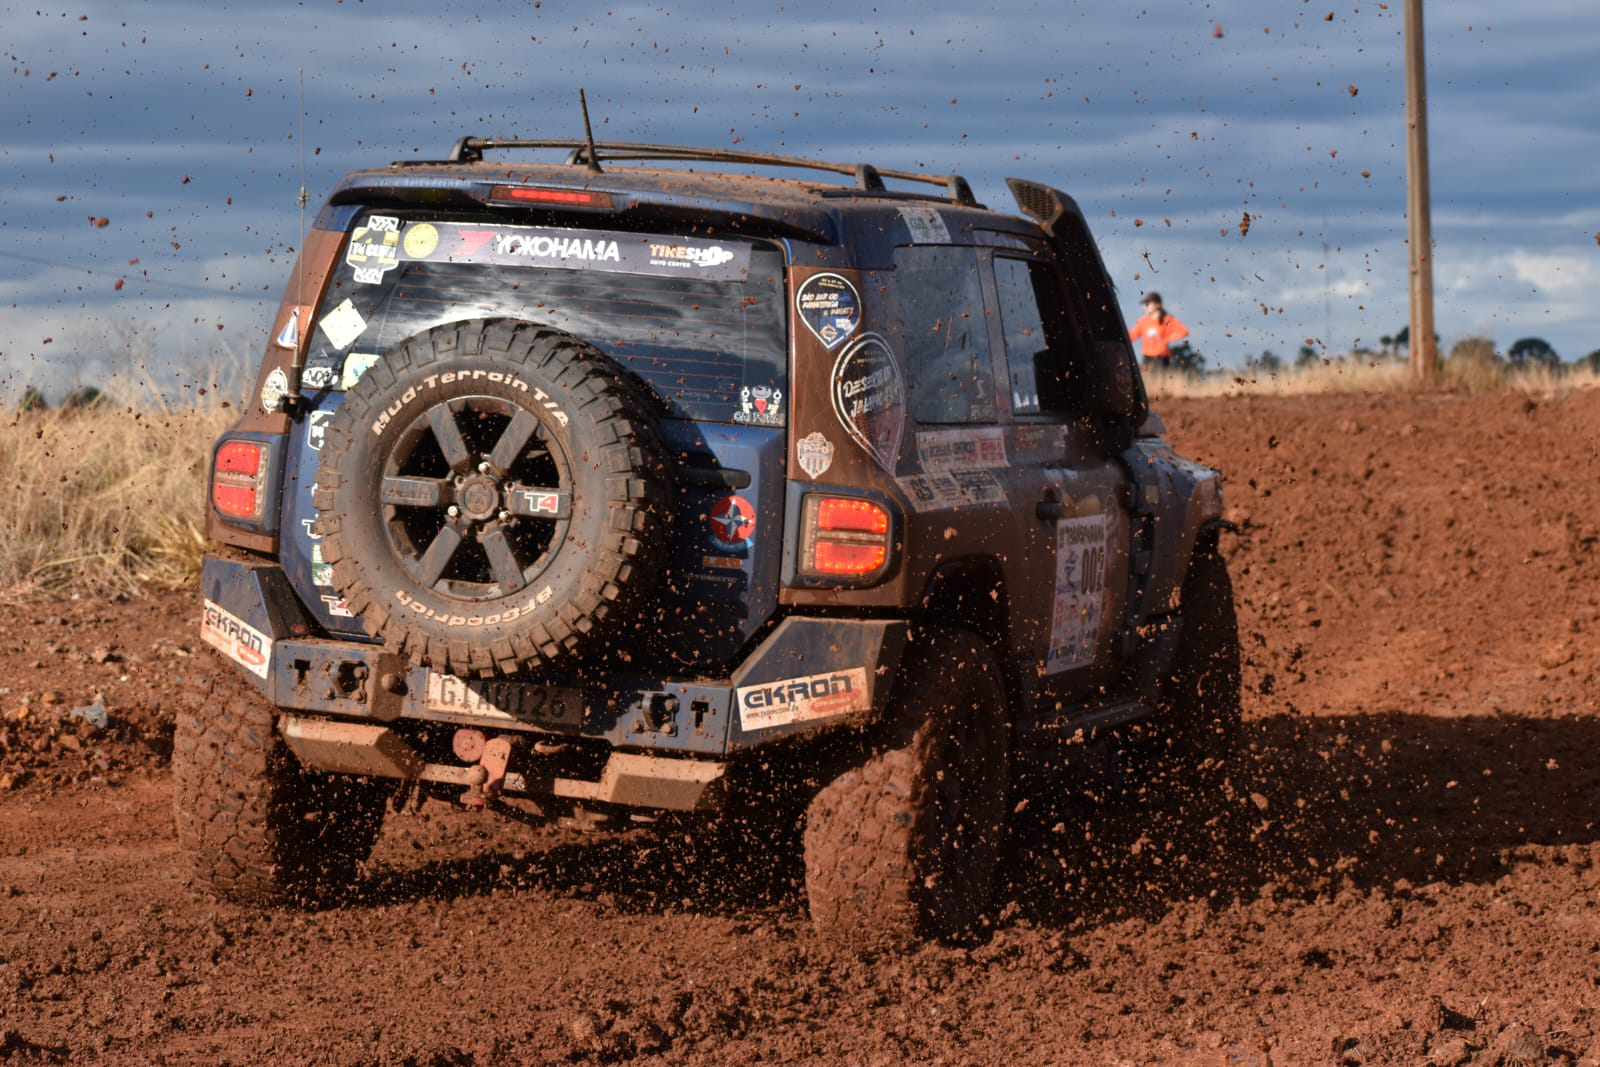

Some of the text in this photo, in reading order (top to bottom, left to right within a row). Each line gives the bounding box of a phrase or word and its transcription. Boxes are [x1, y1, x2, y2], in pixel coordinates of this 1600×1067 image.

[496, 235, 620, 262] YOKOHAMA
[371, 369, 570, 436] Mud-Terrain T/A
[524, 493, 559, 514] T4
[396, 585, 552, 626] BFGoodrich
[207, 607, 263, 654] EKRON
[744, 675, 852, 709] EKRON
